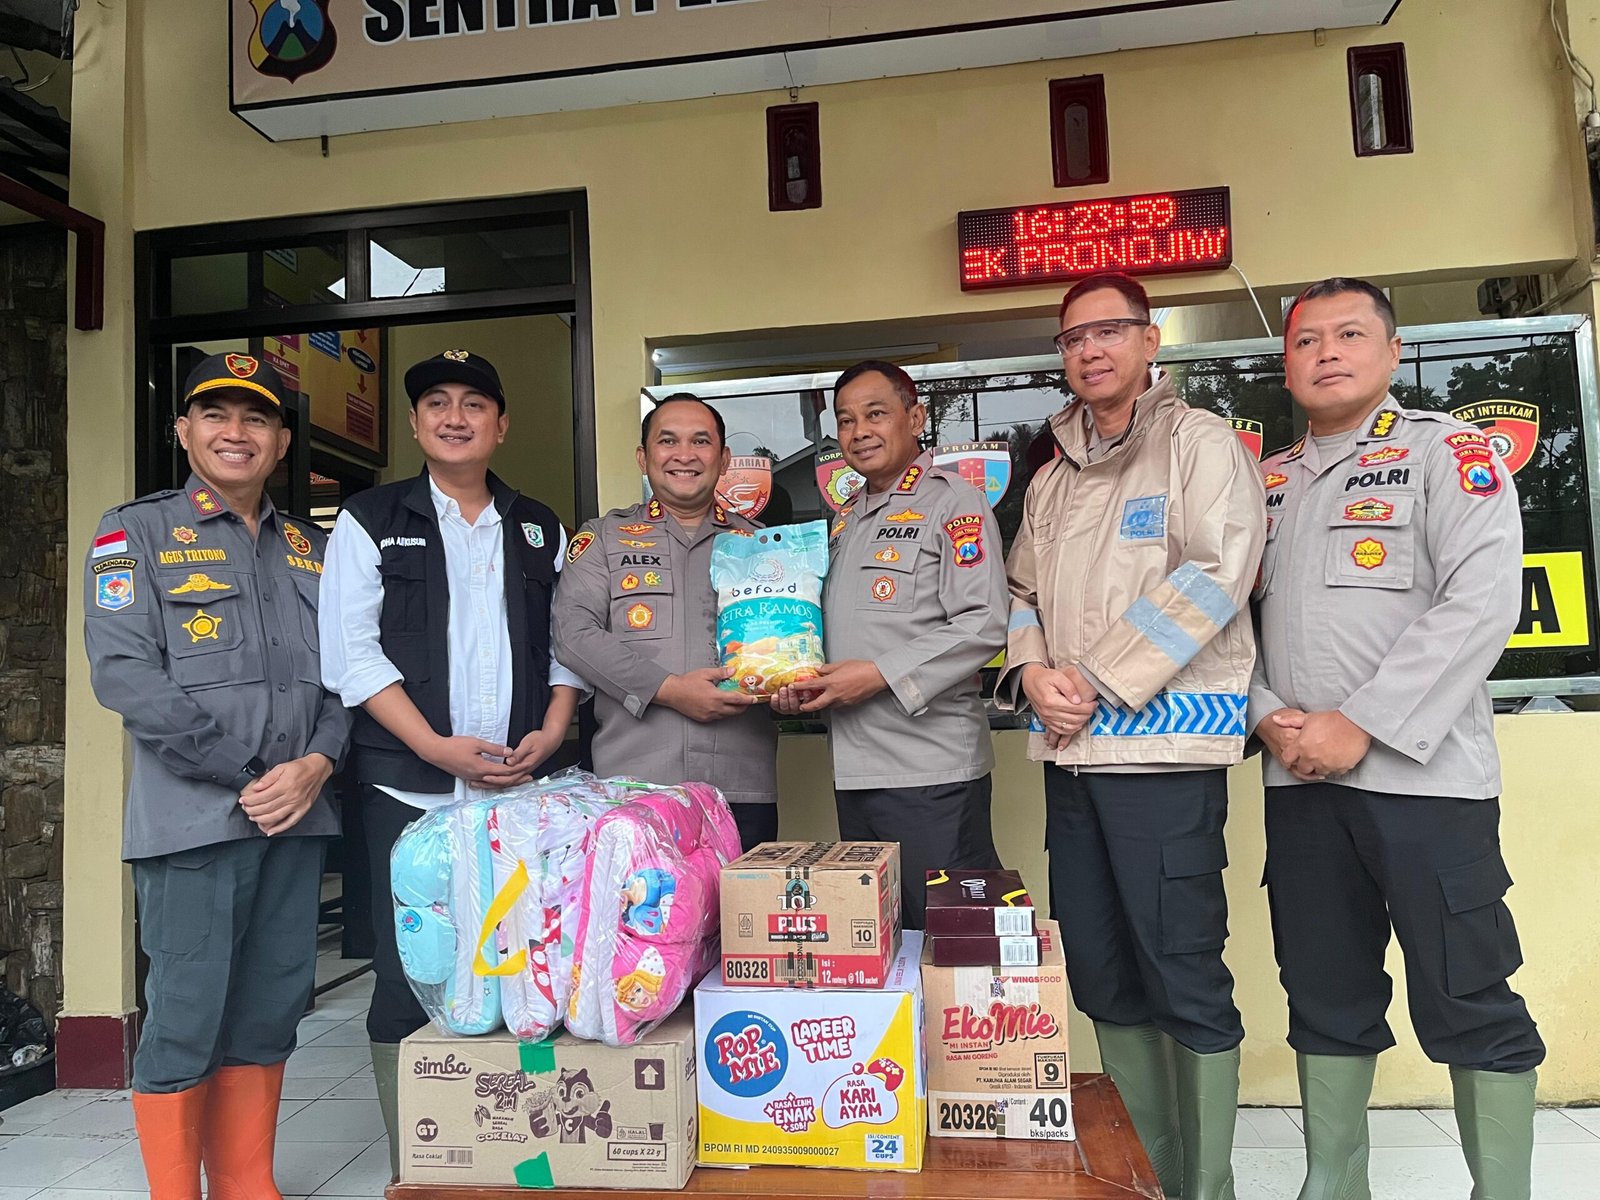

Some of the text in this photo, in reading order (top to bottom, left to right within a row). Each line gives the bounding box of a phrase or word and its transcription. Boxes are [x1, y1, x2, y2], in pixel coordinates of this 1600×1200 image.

[1015, 197, 1177, 240] 16:23:59
[1455, 405, 1534, 421] SAT INTELKAM
[1450, 434, 1486, 446] POLDA
[942, 443, 999, 453] PROPAM
[1345, 468, 1410, 492] POLRI
[947, 516, 980, 531] POLDA
[876, 526, 921, 540] POLRI
[159, 549, 227, 564] AGUS TRIYONO
[620, 555, 662, 567] ALEX
[95, 559, 135, 572] KEMENDAGRI
[760, 601, 813, 619] RAMOS
[777, 894, 818, 911] TOP
[777, 916, 817, 932] PLUS
[855, 929, 872, 942] 10
[726, 960, 769, 979] 80328
[821, 970, 832, 984] 12
[847, 972, 855, 984] @
[854, 970, 865, 984] 10
[1011, 976, 1062, 984] WINGSFOOD
[942, 1002, 1059, 1042] EkoMie
[792, 1016, 855, 1046] LAPEER
[715, 1024, 762, 1066] POP
[804, 1038, 852, 1063] TIME
[960, 1041, 989, 1049] INSTAN
[729, 1042, 781, 1084] MIE
[971, 1052, 998, 1060] GORENG
[413, 1053, 472, 1075] simba
[1043, 1063, 1060, 1082] 9
[475, 1069, 536, 1098] SEREAL
[846, 1079, 866, 1087] RASA
[773, 1098, 812, 1109] RASA LEBIH
[839, 1087, 876, 1105] KARI
[773, 1106, 814, 1125] ENAK
[839, 1103, 882, 1120] AYAM
[940, 1102, 997, 1130] 20326
[1029, 1097, 1068, 1128] 40
[416, 1124, 437, 1136] GT
[789, 1122, 808, 1132] SOB!
[1030, 1129, 1069, 1139] bks/packs
[476, 1132, 528, 1143] COKELAT
[612, 1147, 622, 1155] 60
[656, 1149, 661, 1157] g
[704, 1143, 839, 1156] BPOM RI MD 240935009000027
[871, 1140, 898, 1154] 24
